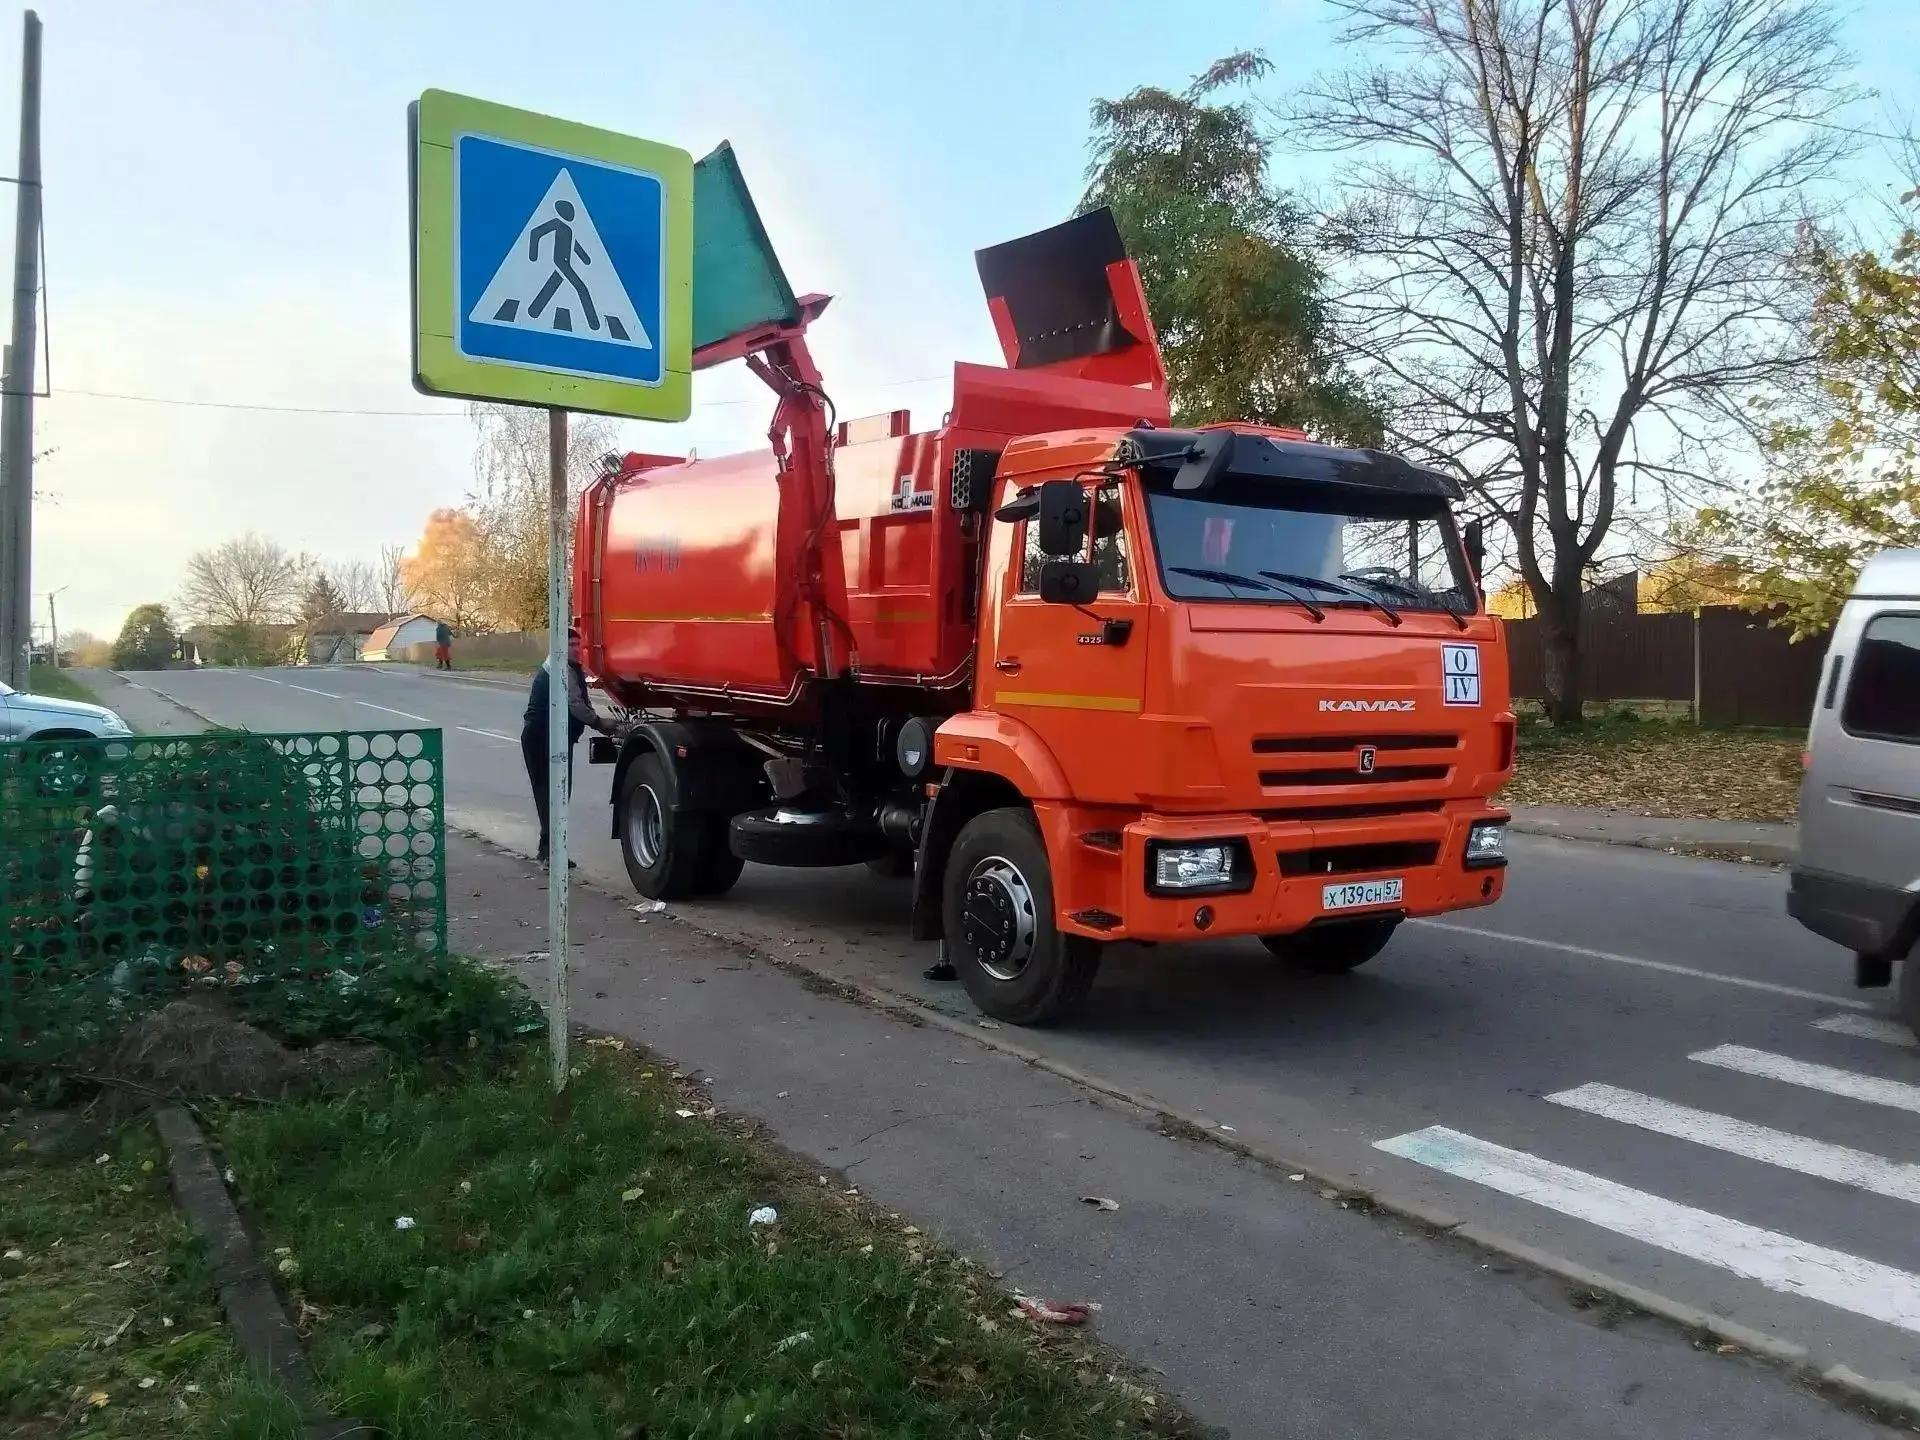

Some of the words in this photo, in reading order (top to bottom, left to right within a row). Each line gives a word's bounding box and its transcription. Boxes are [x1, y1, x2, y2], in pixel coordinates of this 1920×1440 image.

[1078, 636, 1102, 644] 4325
[1452, 677, 1473, 700] IV
[1319, 700, 1416, 712] KAMAZ
[1385, 881, 1399, 896] 57
